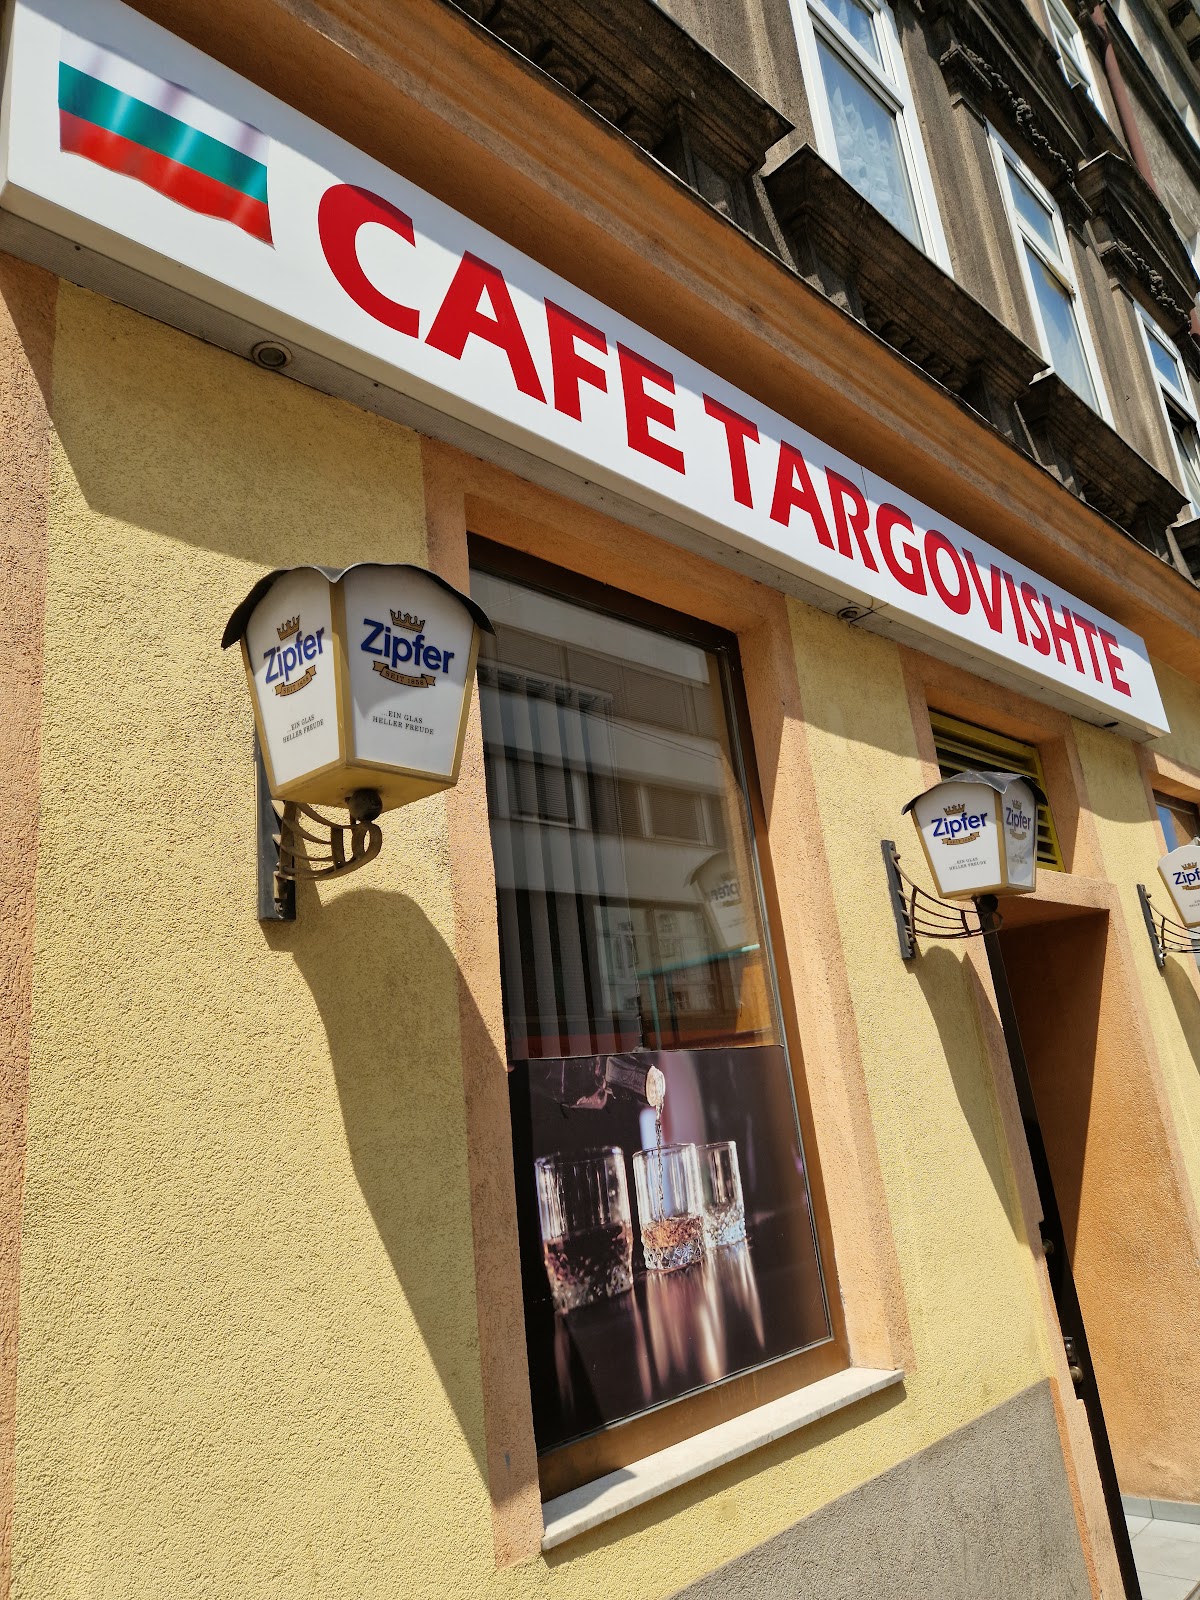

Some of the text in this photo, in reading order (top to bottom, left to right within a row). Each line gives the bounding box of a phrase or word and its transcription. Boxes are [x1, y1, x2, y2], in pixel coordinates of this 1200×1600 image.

[318, 184, 1132, 698] CAFE TARGOVISHTE
[263, 627, 325, 684] Zipfer
[360, 618, 455, 673] Zipfer
[385, 670, 424, 686] SEIT 1858
[282, 718, 325, 744] HELLER FREUDE
[301, 714, 315, 726] GLAS
[372, 716, 434, 735] HELLER FREUDE
[404, 714, 423, 724] GLAS
[931, 812, 988, 838] Zipfer
[1006, 806, 1031, 831] Zipfer
